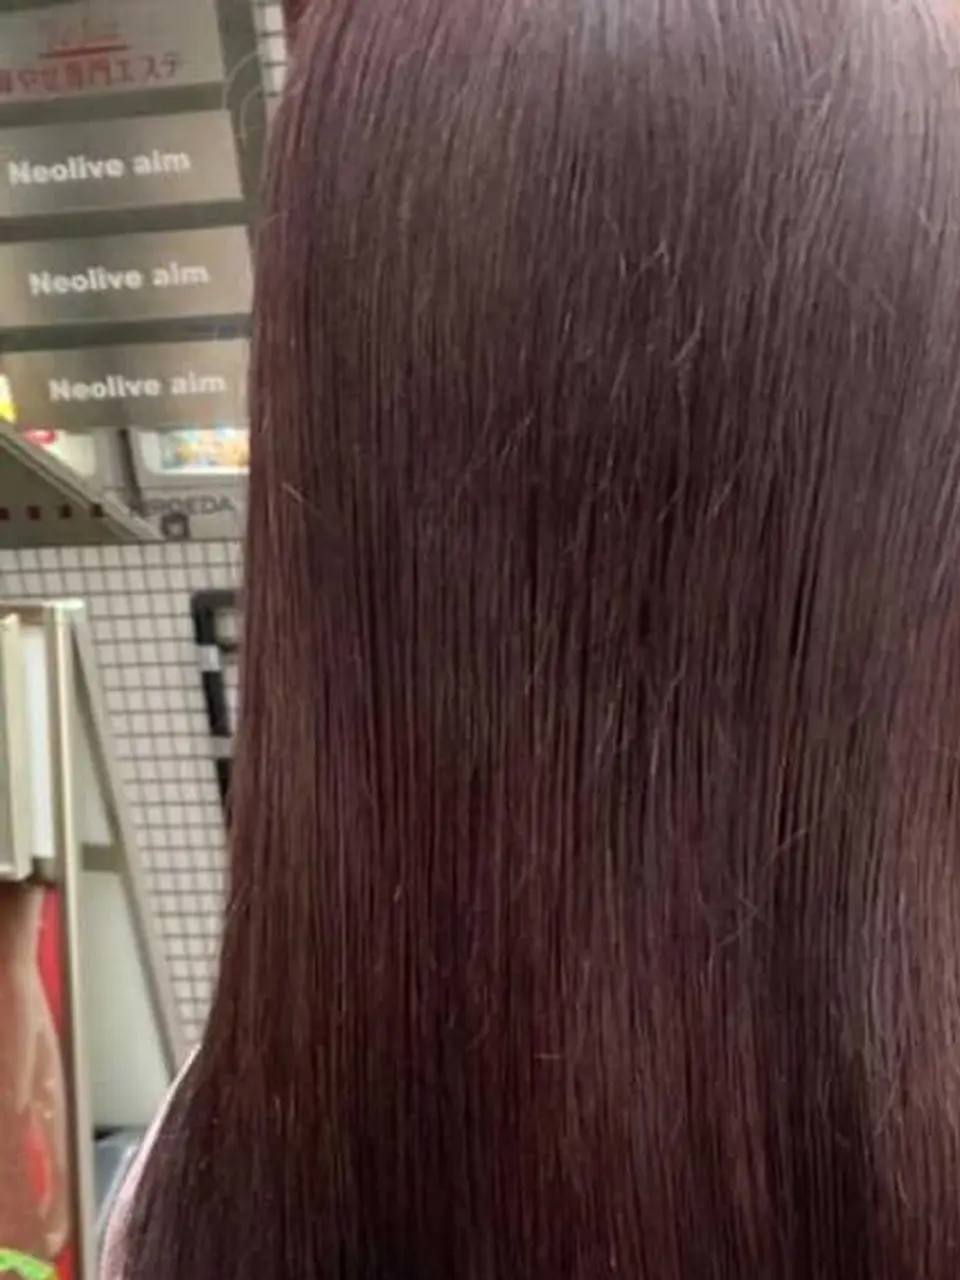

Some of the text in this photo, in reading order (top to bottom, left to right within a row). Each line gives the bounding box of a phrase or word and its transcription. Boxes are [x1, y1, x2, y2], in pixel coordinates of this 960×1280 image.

[8, 149, 191, 186] Neolive aim
[29, 261, 211, 296] Neolive aim
[49, 371, 228, 402] Neolive aim
